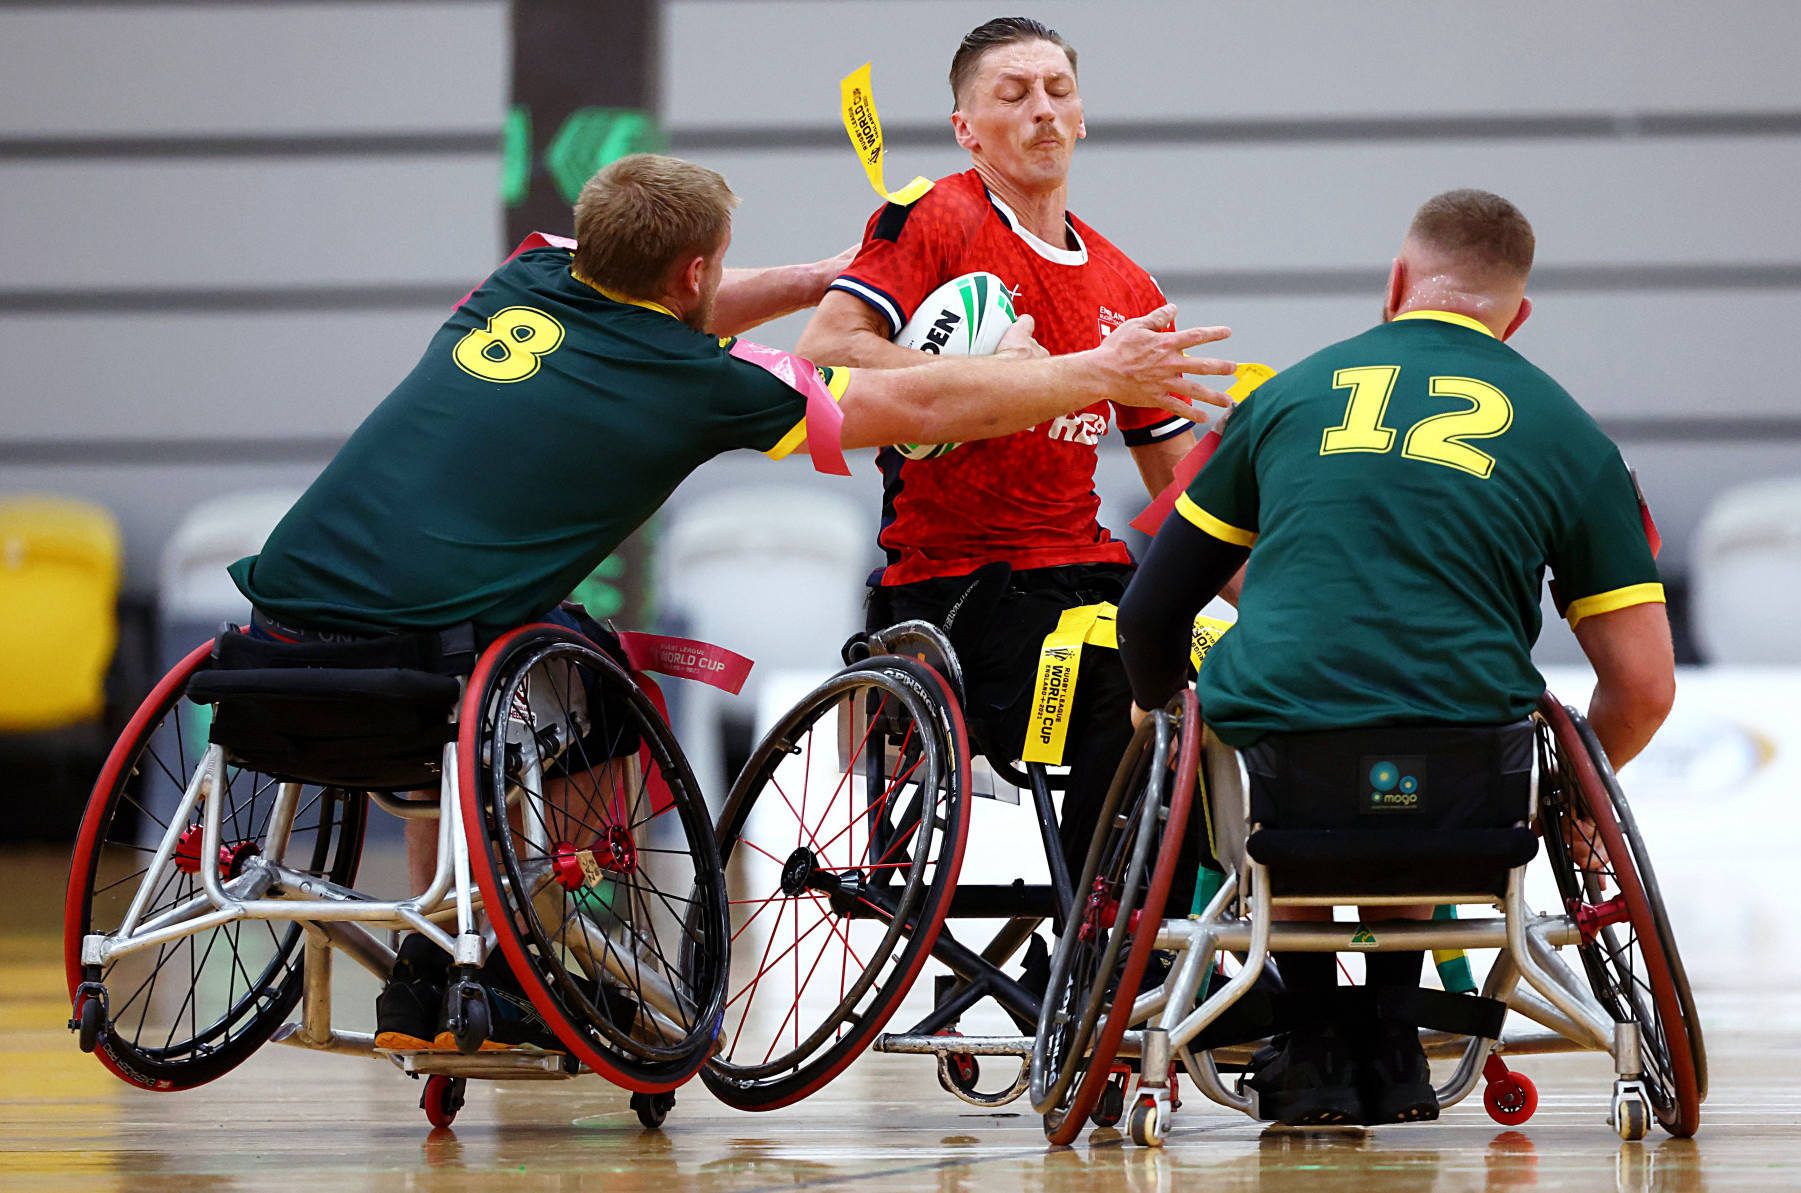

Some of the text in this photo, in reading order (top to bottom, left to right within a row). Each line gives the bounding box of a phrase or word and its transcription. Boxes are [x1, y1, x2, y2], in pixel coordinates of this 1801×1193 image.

[853, 105, 876, 147] WORLD
[855, 129, 868, 150] RUGBY
[452, 306, 565, 383] 8
[1320, 365, 1514, 479] 12
[662, 650, 696, 665] WORLD
[699, 658, 725, 672] CUP
[680, 647, 704, 655] LEAGUE
[1042, 665, 1051, 698] ENGLAND
[1056, 668, 1071, 722] RUGBY LEAGUE
[1040, 665, 1063, 744] WORLD CUP
[1384, 794, 1418, 805] mogo
